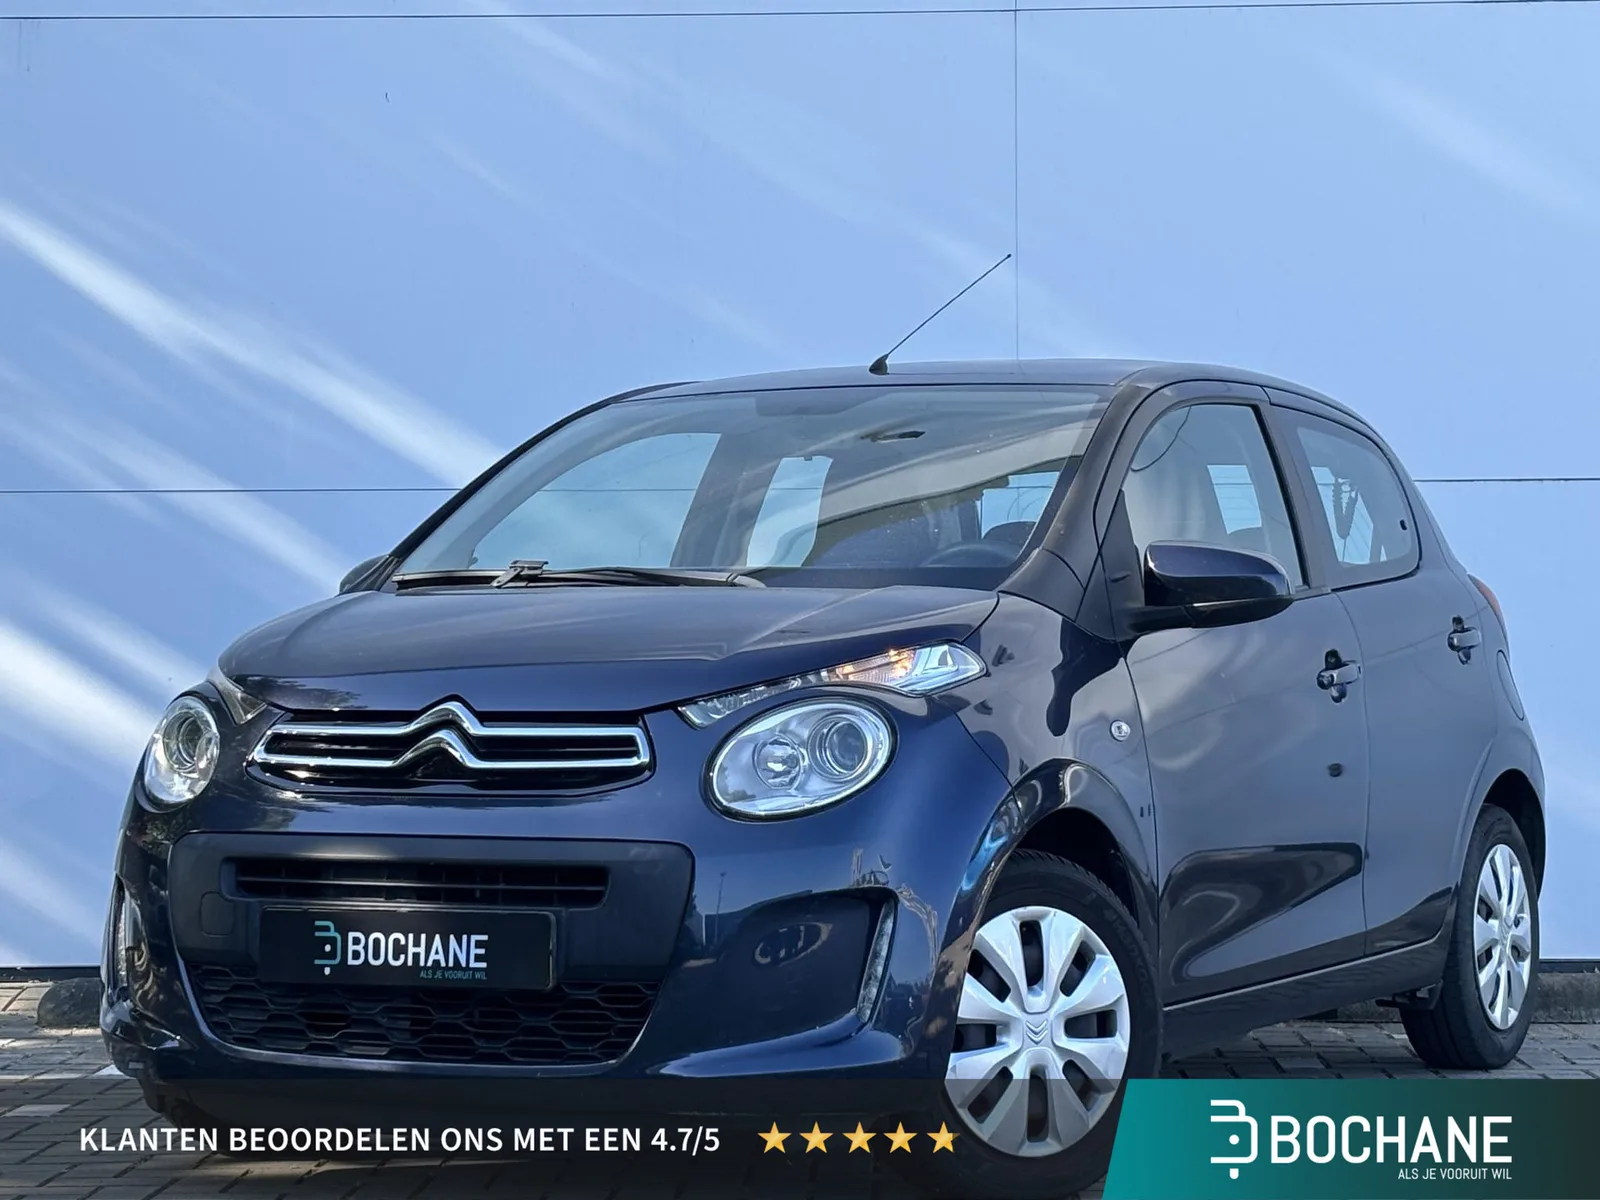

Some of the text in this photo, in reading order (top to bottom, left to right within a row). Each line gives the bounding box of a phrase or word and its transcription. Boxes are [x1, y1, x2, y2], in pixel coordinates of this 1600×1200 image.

[347, 931, 489, 968] BOCHANE
[420, 969, 487, 981] ALS JE VOORUIT WIL
